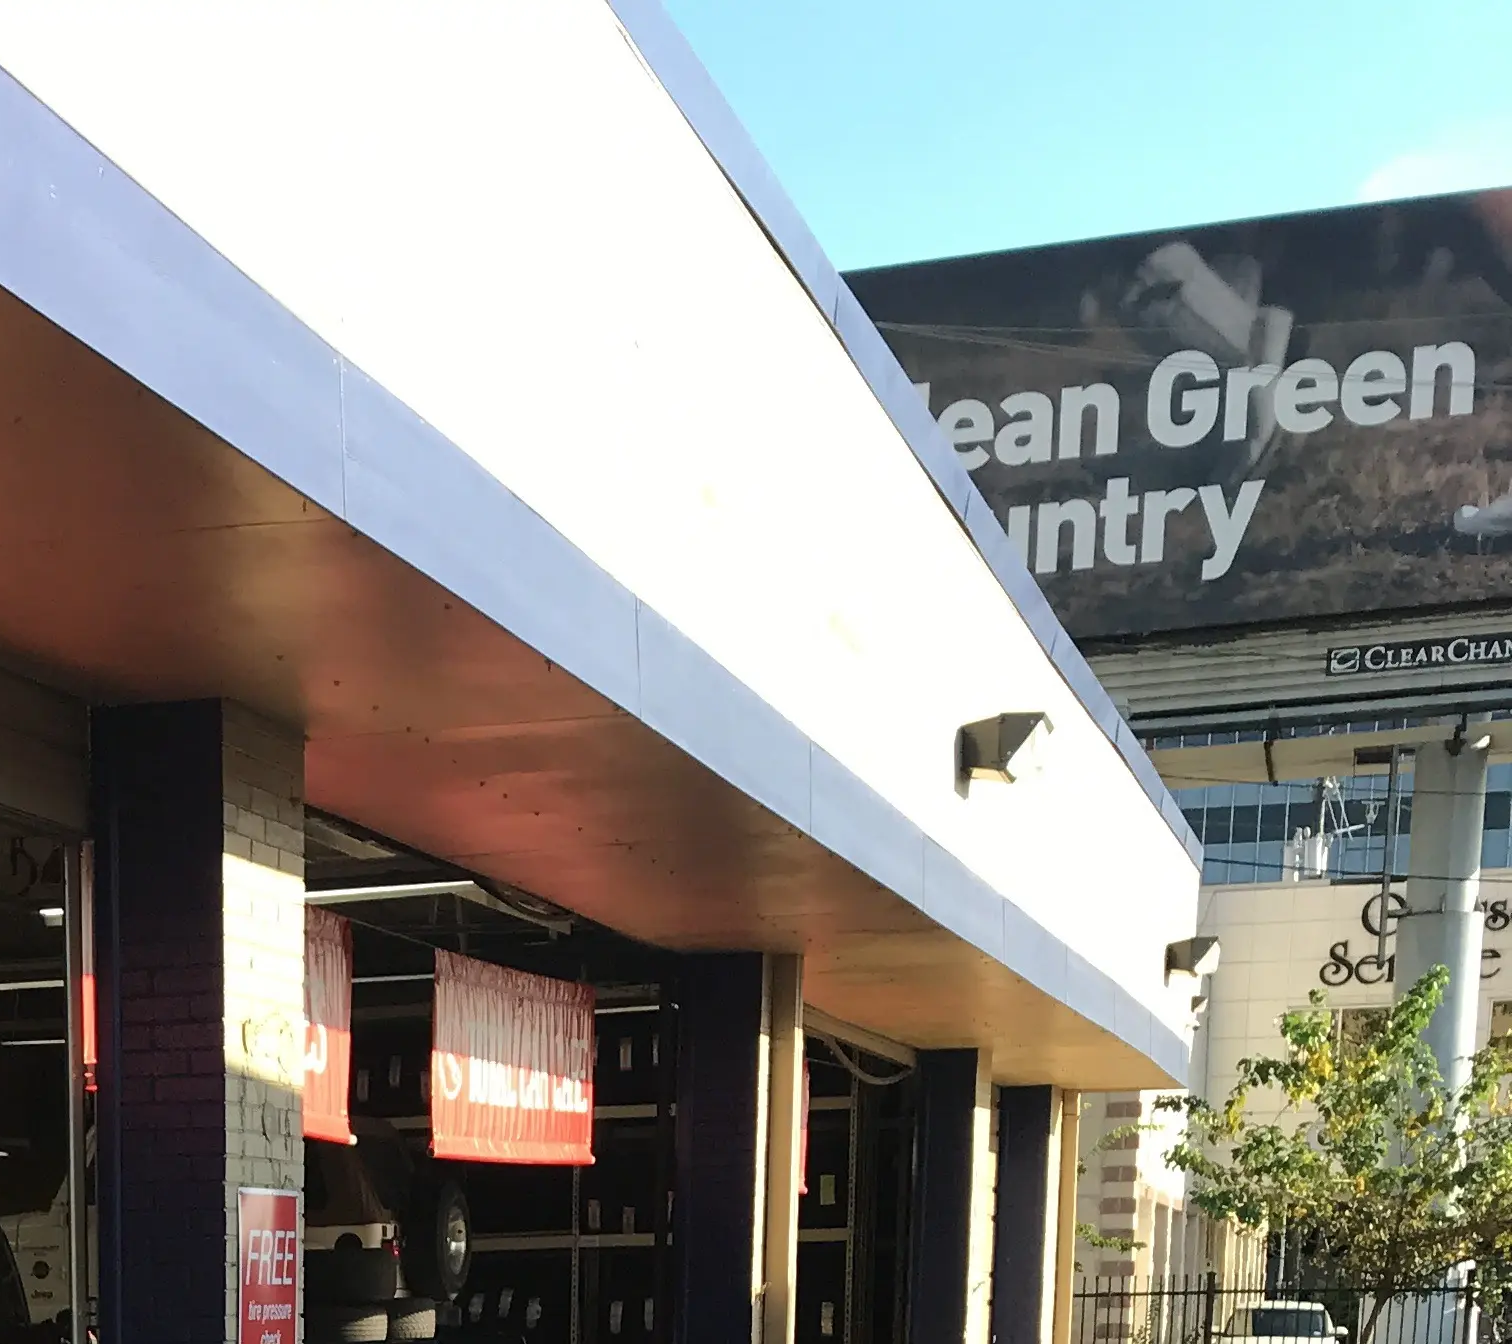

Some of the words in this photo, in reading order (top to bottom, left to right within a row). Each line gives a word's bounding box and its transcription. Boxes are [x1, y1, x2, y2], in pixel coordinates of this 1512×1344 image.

[1147, 340, 1476, 448] Green
[245, 1229, 296, 1286] FREE
[248, 1300, 262, 1320] tire
[261, 1303, 292, 1325] pressure
